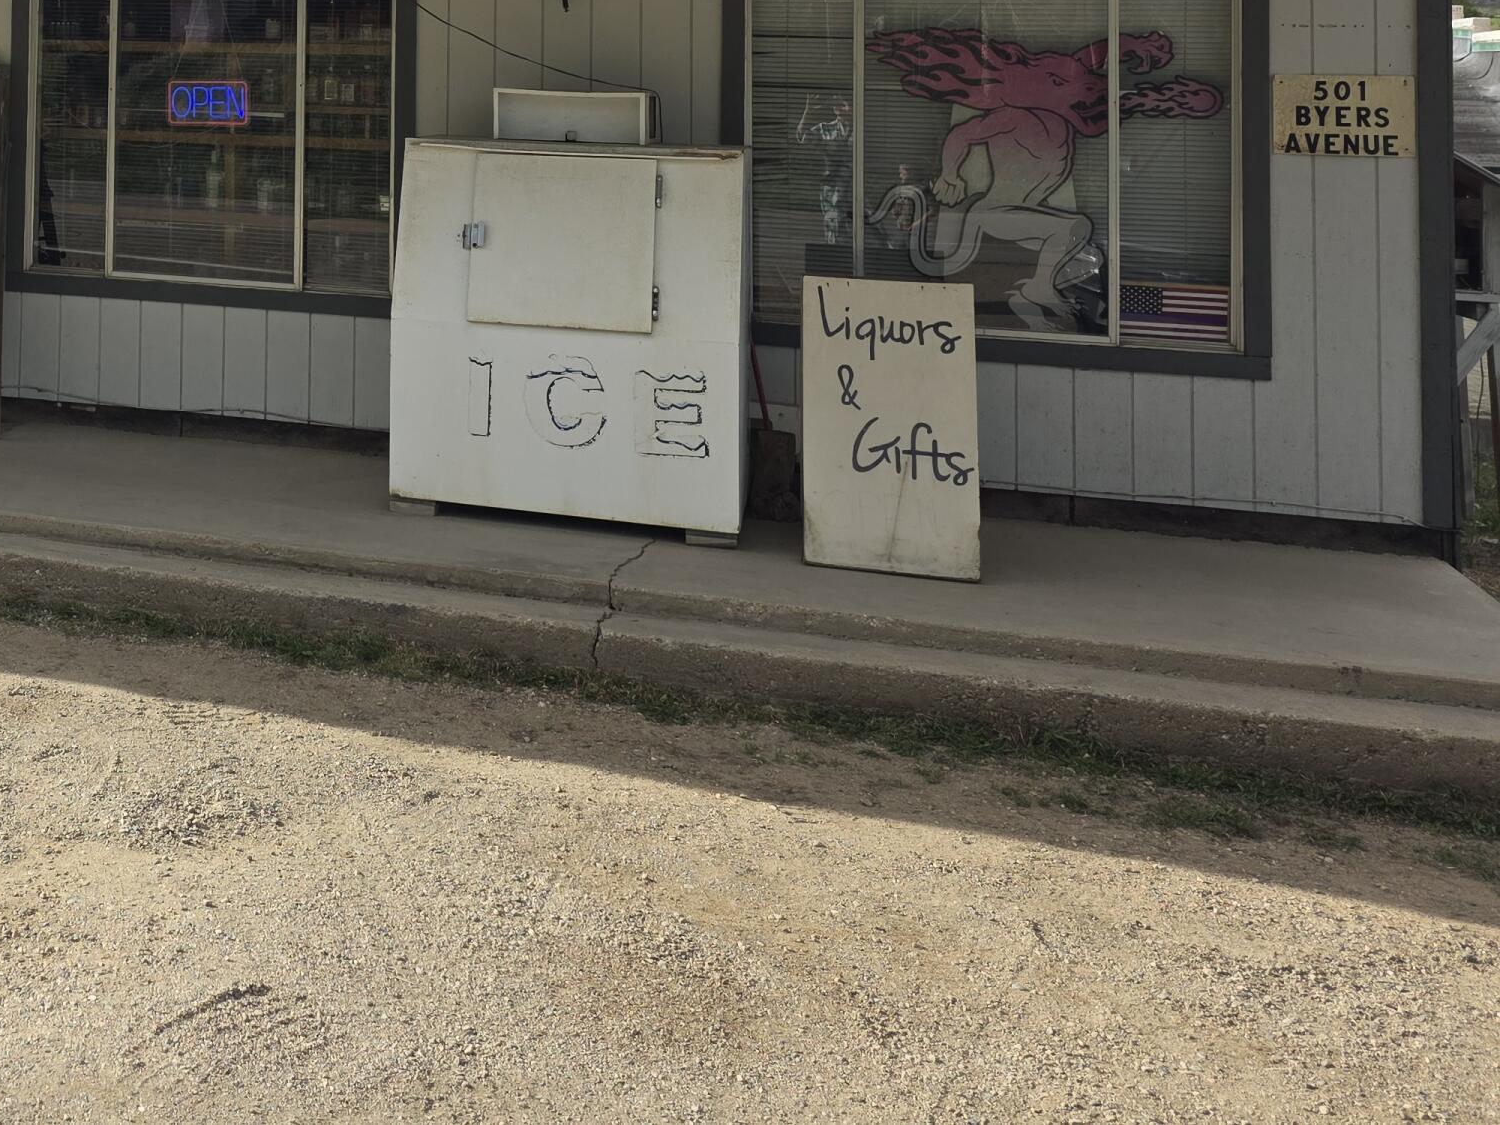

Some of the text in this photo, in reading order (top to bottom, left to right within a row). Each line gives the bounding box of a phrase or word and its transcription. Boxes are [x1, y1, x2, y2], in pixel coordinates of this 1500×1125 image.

[172, 86, 244, 119] OPEN
[1313, 80, 1366, 102] 501
[1295, 105, 1390, 128] BYERS
[1284, 132, 1399, 156] AVENUE
[817, 285, 962, 361] Liquors
[468, 353, 710, 458] ICE
[837, 364, 862, 411] &
[852, 416, 975, 486] Gifts
